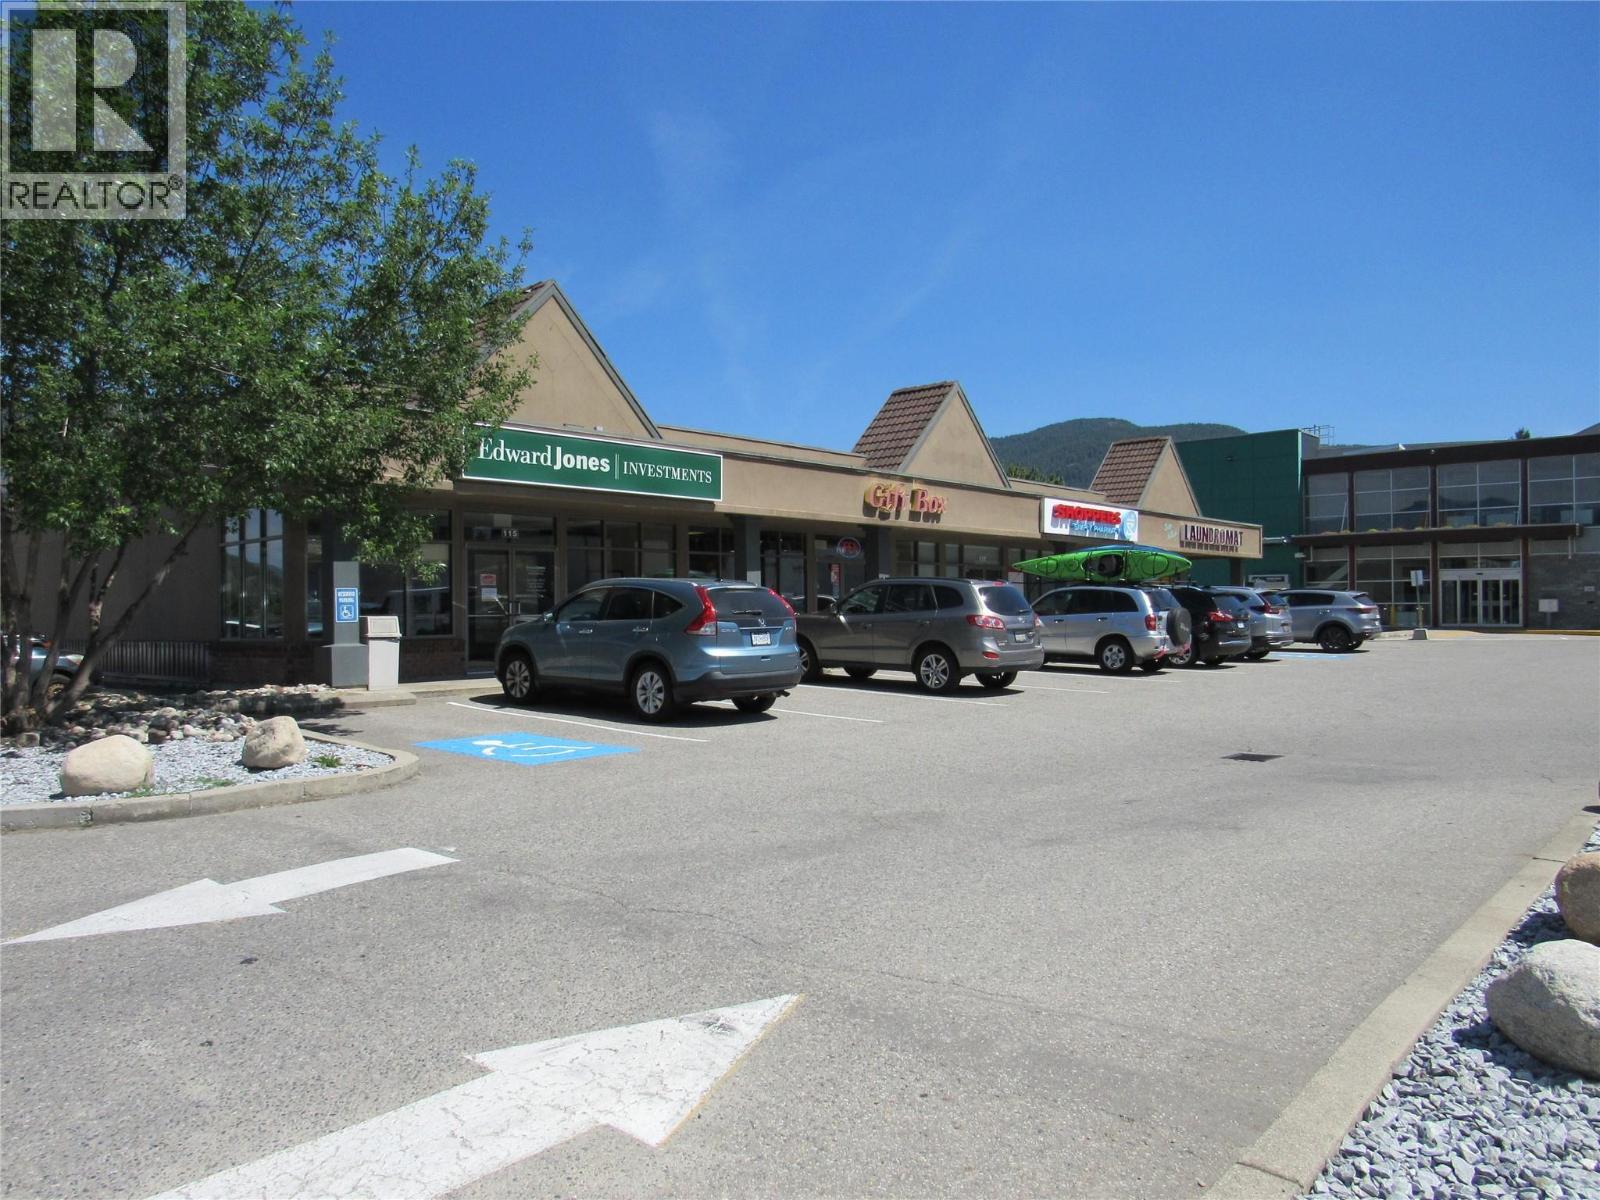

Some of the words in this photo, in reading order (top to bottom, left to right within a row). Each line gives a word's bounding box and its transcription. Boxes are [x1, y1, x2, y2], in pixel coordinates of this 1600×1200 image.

[554, 446, 611, 473] Jones
[623, 461, 713, 484] INVESTMENTS
[865, 482, 907, 513] Gift
[912, 487, 949, 514] Box
[1053, 503, 1122, 525] SHOPPERS
[1182, 523, 1244, 547] LAUNDROMAT
